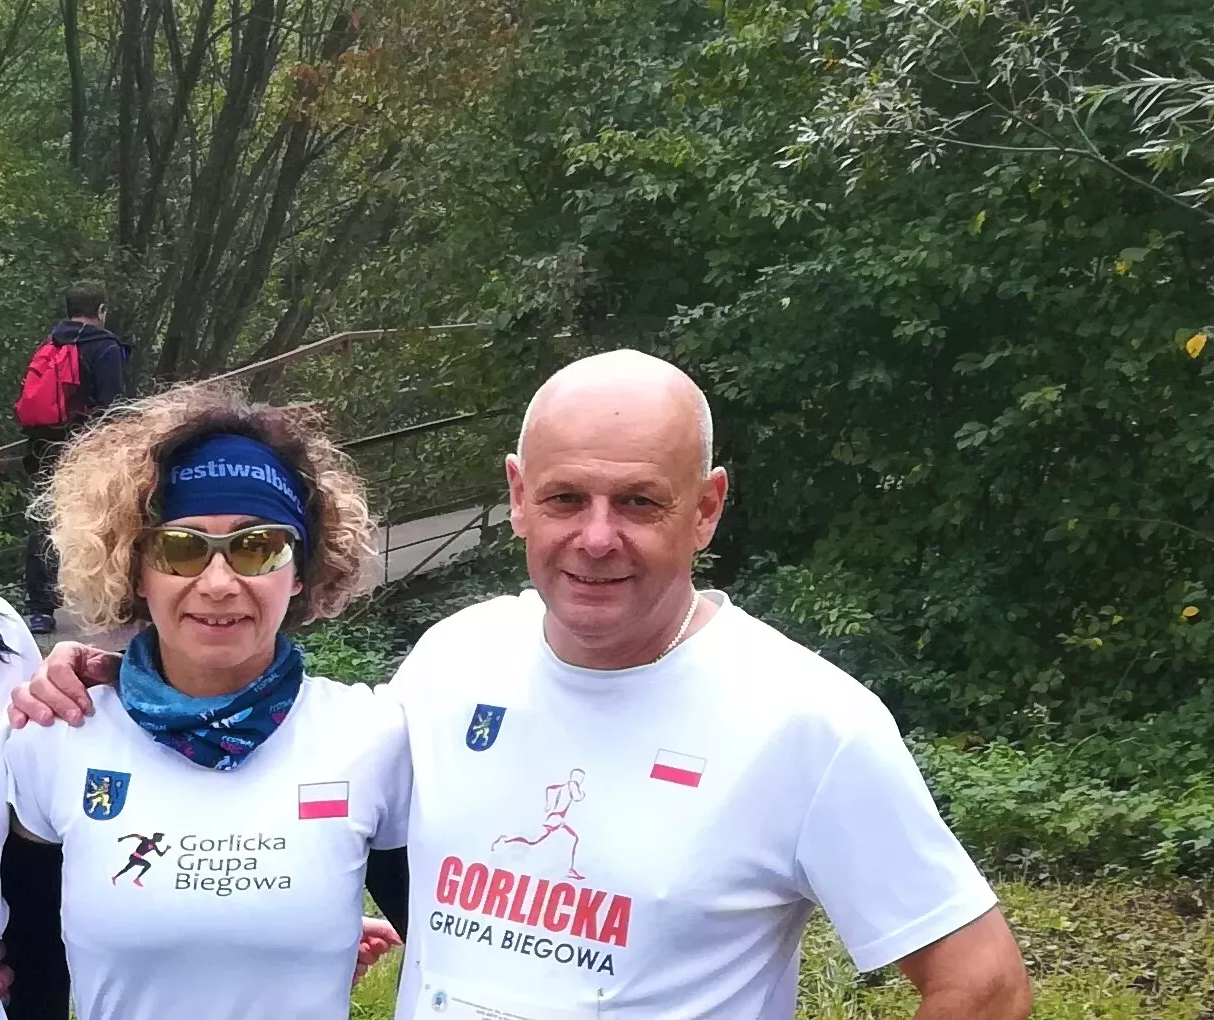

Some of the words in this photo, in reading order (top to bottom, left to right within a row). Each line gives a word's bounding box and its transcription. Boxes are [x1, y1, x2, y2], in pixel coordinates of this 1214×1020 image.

[179, 833, 286, 852] Gorlicka
[177, 853, 257, 876] Grupa
[174, 872, 292, 897] Biegowa
[435, 856, 632, 948] GORLICKA
[429, 911, 493, 946] GRUPA
[501, 929, 615, 976] BIEGOWA
